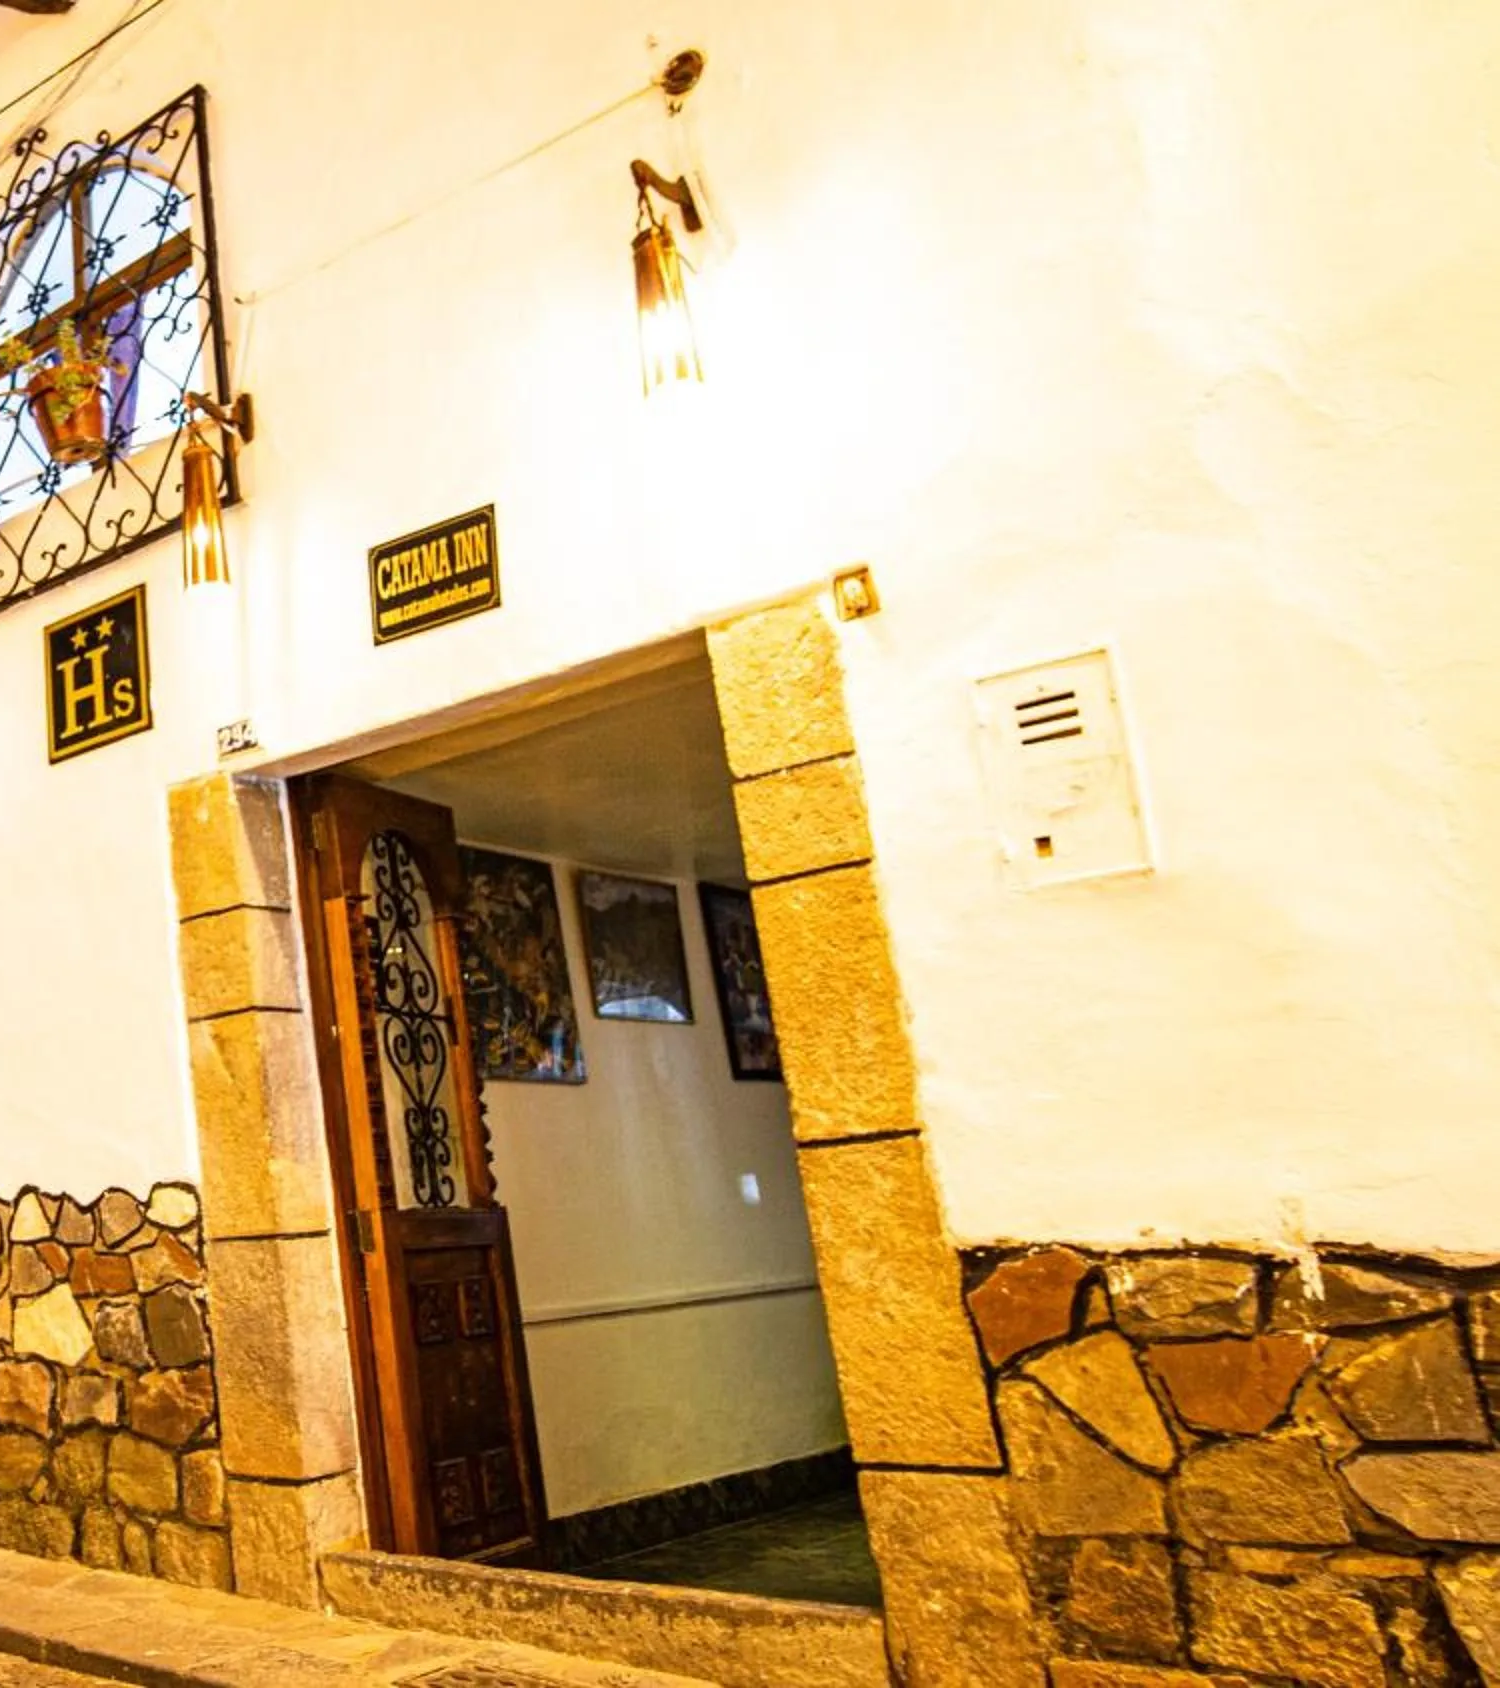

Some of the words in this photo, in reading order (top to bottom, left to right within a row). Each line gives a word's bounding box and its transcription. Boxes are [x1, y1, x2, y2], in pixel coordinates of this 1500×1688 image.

[377, 537, 452, 600] CATAMA
[452, 523, 488, 574] INN
[56, 644, 136, 740] Hs
